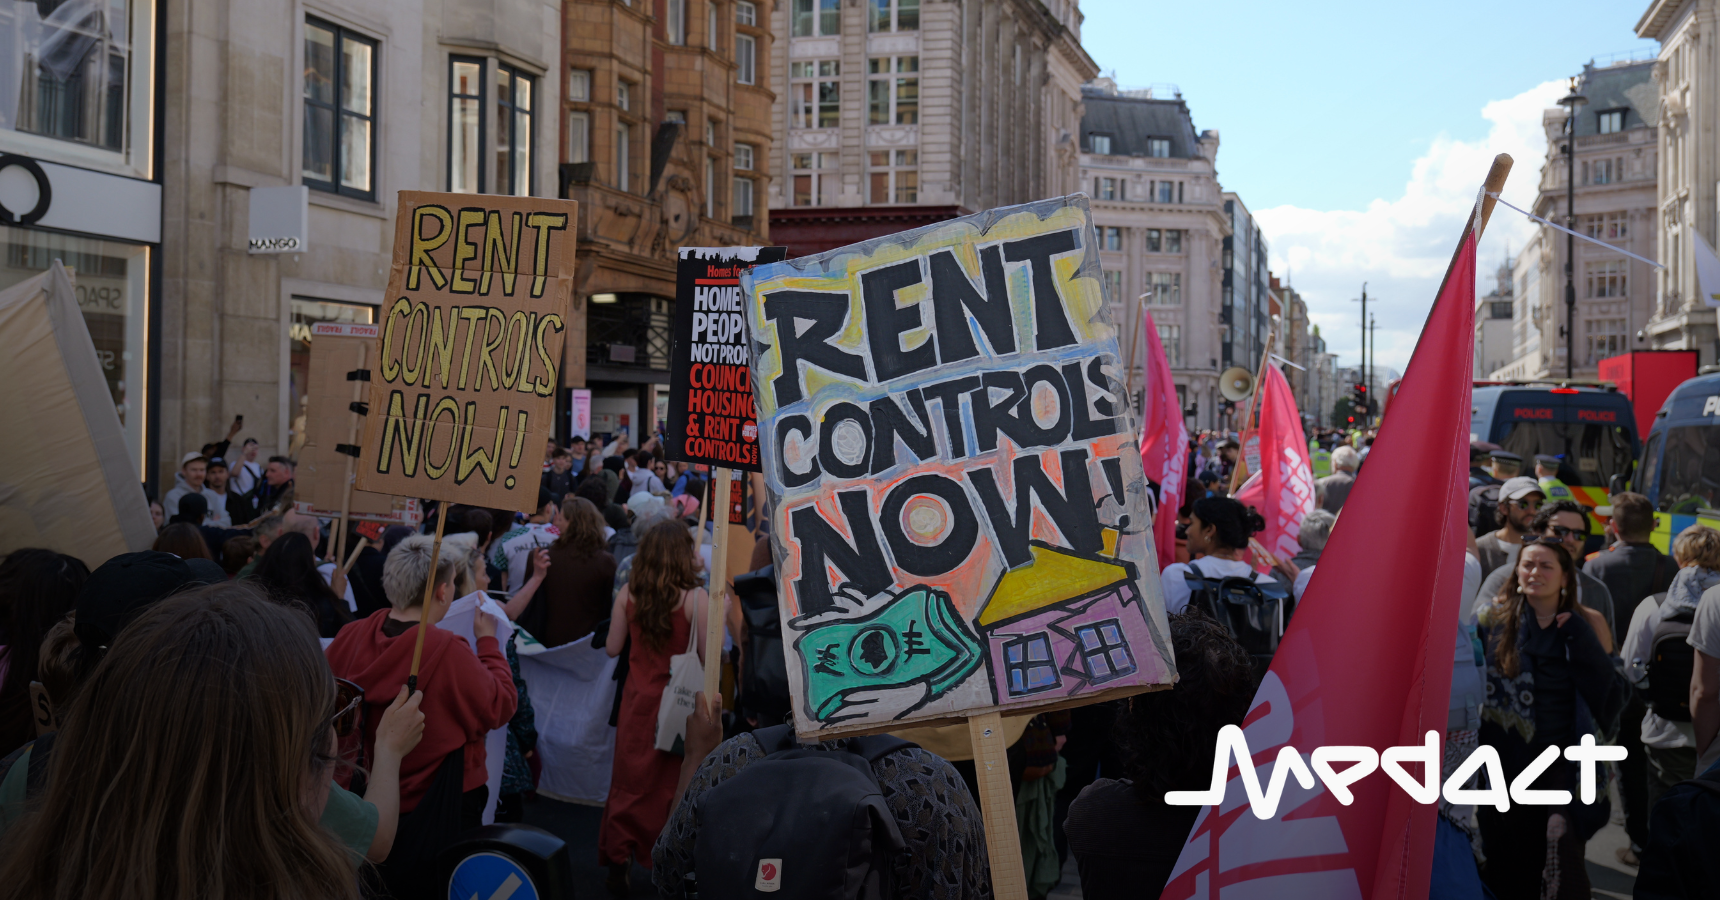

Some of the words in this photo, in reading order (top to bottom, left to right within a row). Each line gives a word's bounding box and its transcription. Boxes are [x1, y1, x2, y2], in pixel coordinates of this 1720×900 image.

[249, 237, 299, 249] MANGO
[406, 204, 568, 298] RENT
[707, 264, 731, 278] Homes
[764, 228, 1083, 411] RENT
[381, 297, 564, 397] CONTROLS
[690, 342, 719, 363] NOT
[689, 363, 753, 392] COUNCI
[688, 389, 757, 419] HOUSING
[1514, 408, 1553, 419] POLICE
[1577, 409, 1616, 422] POLICE
[686, 413, 700, 436] &
[704, 415, 740, 441] RENT
[774, 355, 1128, 488] CONTROLS
[377, 389, 528, 490] NOW!
[685, 437, 751, 464] CONTROLS
[791, 448, 1130, 616] NOW!
